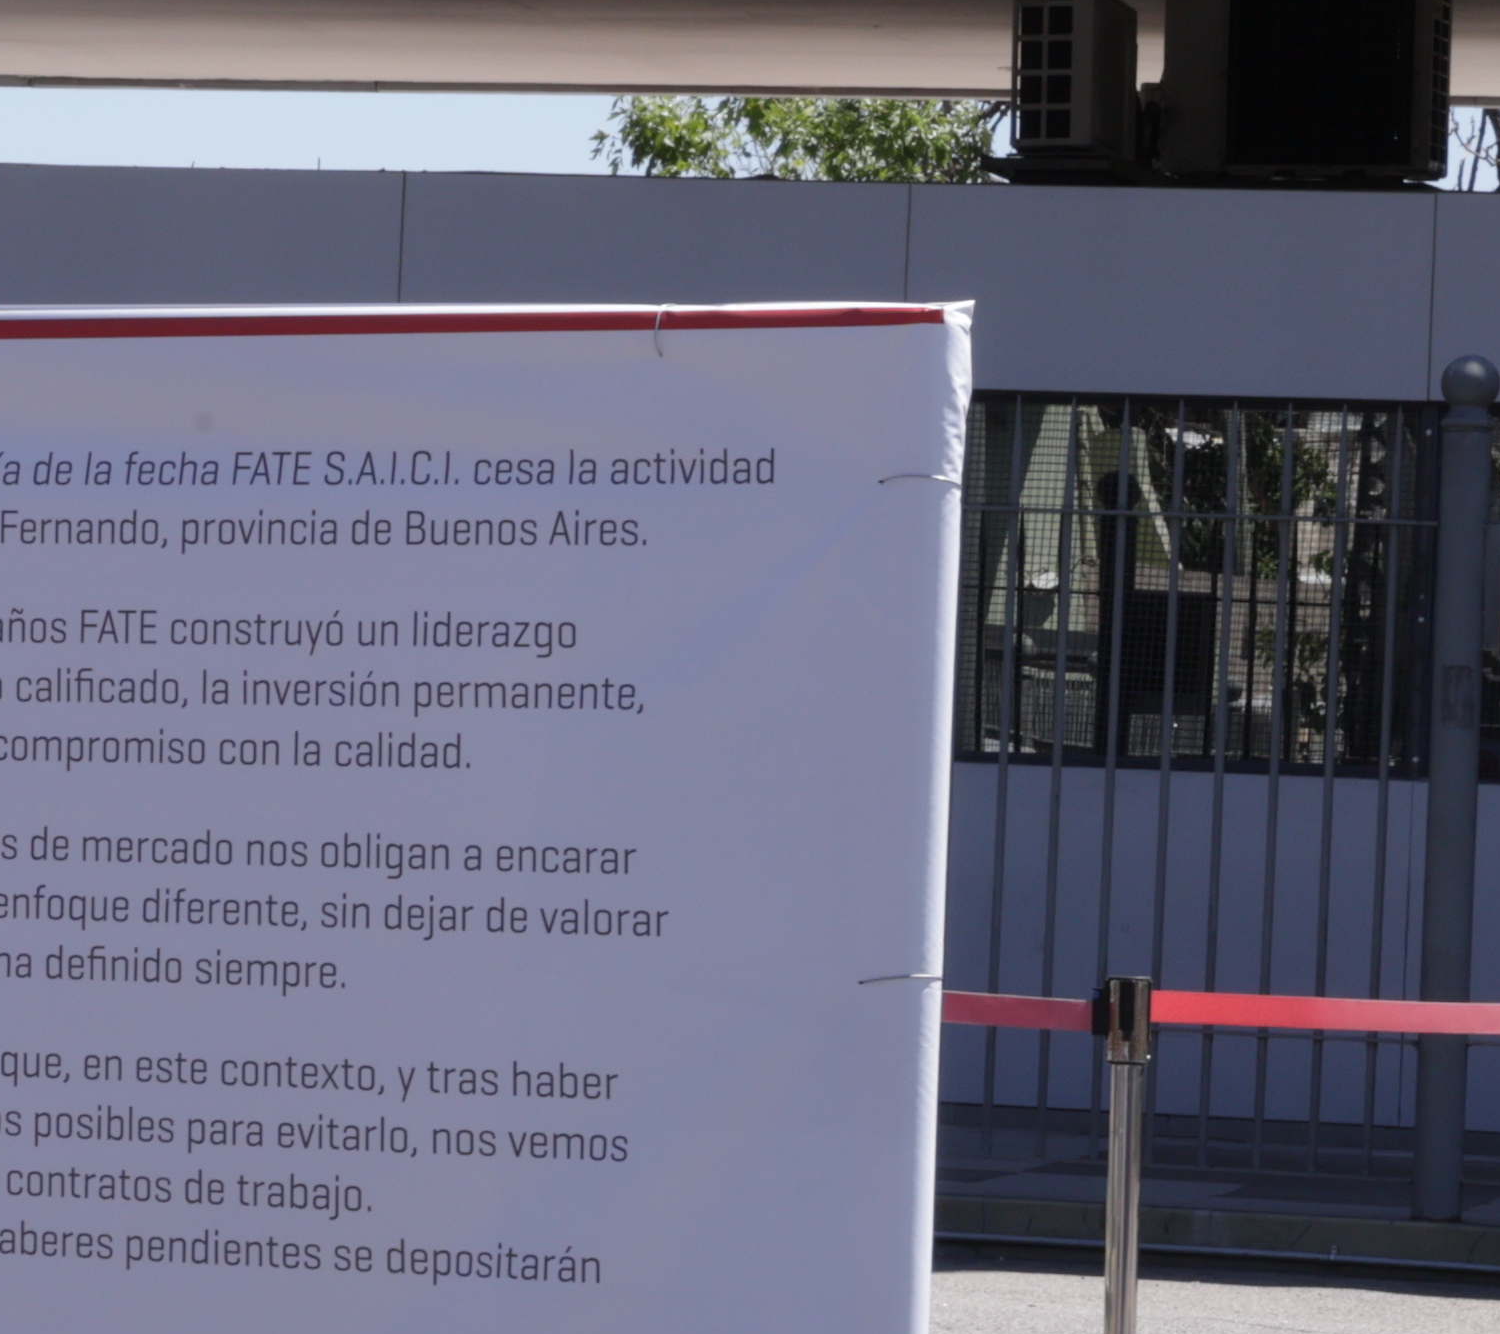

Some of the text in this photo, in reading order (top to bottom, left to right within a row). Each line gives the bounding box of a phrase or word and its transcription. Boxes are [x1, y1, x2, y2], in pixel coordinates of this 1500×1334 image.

[32, 451, 73, 486] de
[84, 451, 113, 486] la
[124, 450, 220, 486] fecha
[231, 450, 313, 486] FATE
[323, 449, 460, 486] S.A.I.C.I.
[473, 458, 555, 486] cesa
[568, 448, 597, 486] la
[610, 447, 775, 486] actividad
[0, 509, 168, 549] Fernando,
[181, 509, 338, 555] provincia
[351, 509, 392, 546] de
[405, 509, 538, 547] Buenos
[548, 509, 647, 547] Aires.
[80, 608, 158, 645] FATE
[170, 609, 344, 656] construyó
[357, 620, 399, 647] un
[412, 610, 577, 659] liderazgo
[15, 667, 188, 709] calificado,
[202, 669, 229, 706] la
[242, 669, 400, 708] inversión
[413, 677, 644, 718] permanente,
[218, 738, 280, 766] con
[293, 730, 321, 767] la
[334, 731, 471, 770] calidad.
[30, 825, 70, 862] de
[82, 829, 233, 866] mercado
[246, 839, 308, 868] nos
[320, 832, 450, 880] obligan
[463, 844, 482, 872] a
[496, 845, 637, 875] encarar
[142, 887, 308, 932] diferente,
[320, 892, 371, 929] sin
[383, 894, 474, 942] dejar
[486, 896, 528, 934] de
[539, 898, 669, 937] valorar
[0, 1050, 70, 1087] que,
[83, 1054, 123, 1081] en
[135, 1052, 208, 1086] este
[220, 1056, 385, 1096] contexto,
[397, 1066, 416, 1103] y
[426, 1061, 499, 1097] tras
[512, 1060, 619, 1100] haber
[34, 1104, 175, 1147] posibles
[187, 1118, 264, 1154] para
[277, 1113, 418, 1158] evitarlo,
[432, 1128, 497, 1157] nos
[507, 1131, 629, 1163] vemos
[125, 1228, 322, 1271] pendientes
[333, 1244, 373, 1273] se
[386, 1238, 601, 1286] depositarán
